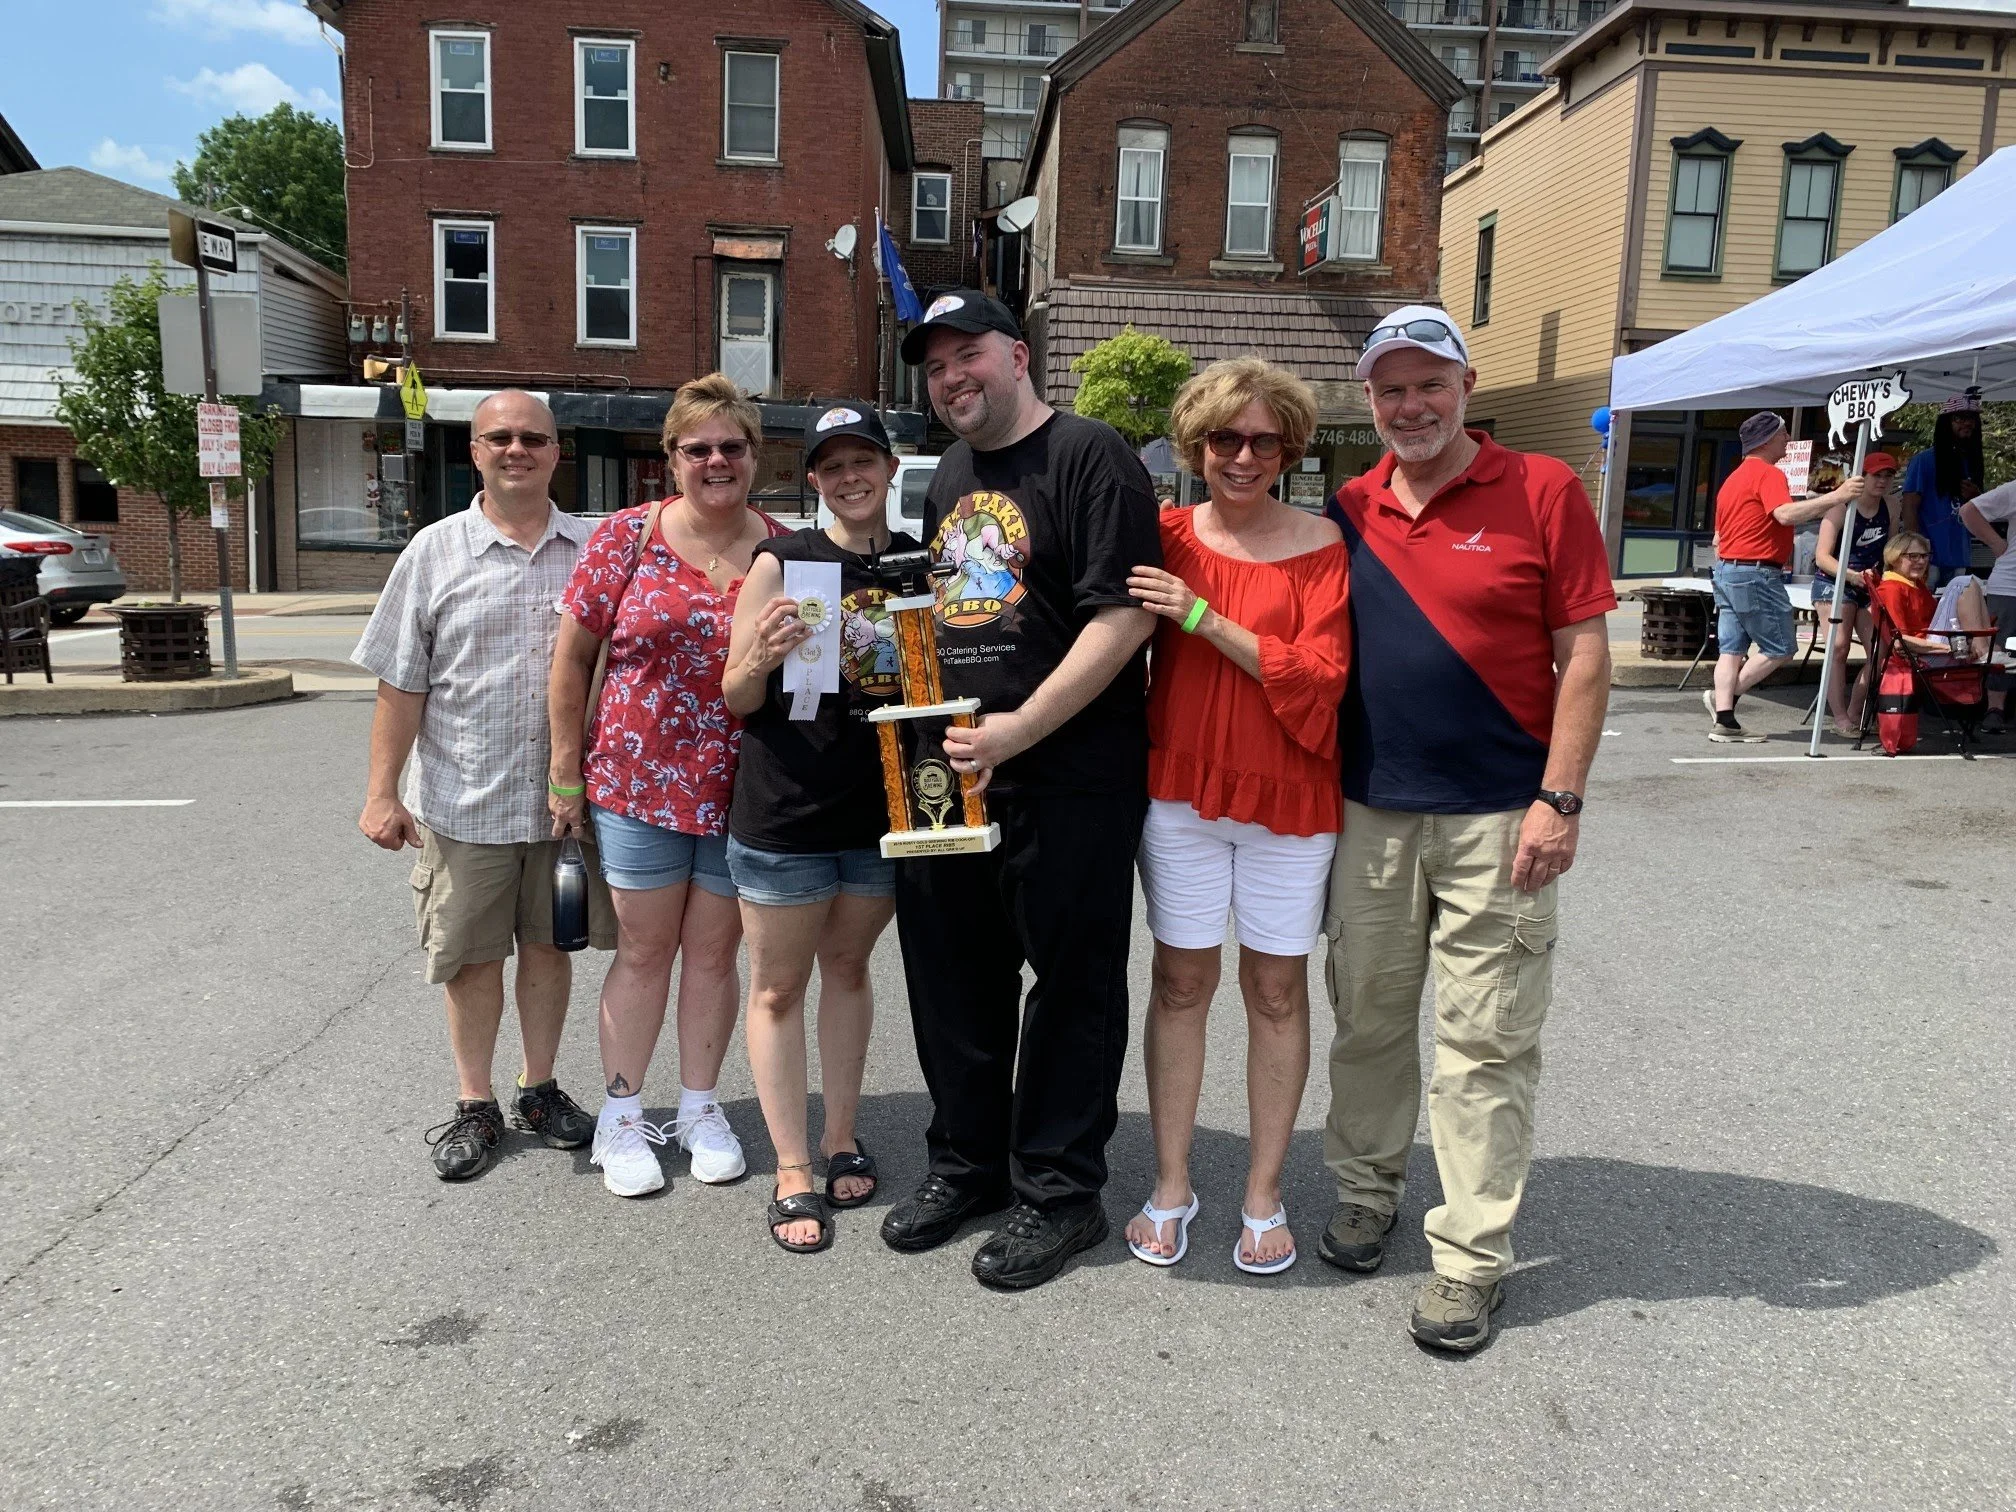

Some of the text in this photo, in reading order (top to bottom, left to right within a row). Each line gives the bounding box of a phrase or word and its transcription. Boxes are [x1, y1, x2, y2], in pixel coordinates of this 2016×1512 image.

[1300, 217, 1326, 246] VOCELLI
[210, 236, 229, 258] WAY
[1833, 381, 1891, 406] CHEWY'S
[200, 404, 226, 416] PARKING
[1848, 400, 1876, 420] BBQ
[200, 418, 222, 432] CLOSED
[201, 439, 214, 452] JULY
[202, 462, 216, 474] JULY
[972, 492, 1028, 544] TAKE
[1862, 527, 1882, 540] NIKE
[1452, 544, 1492, 552] NAUTICA
[943, 600, 1002, 618] BBQ
[946, 646, 978, 656] Catering
[980, 644, 1016, 653] Services
